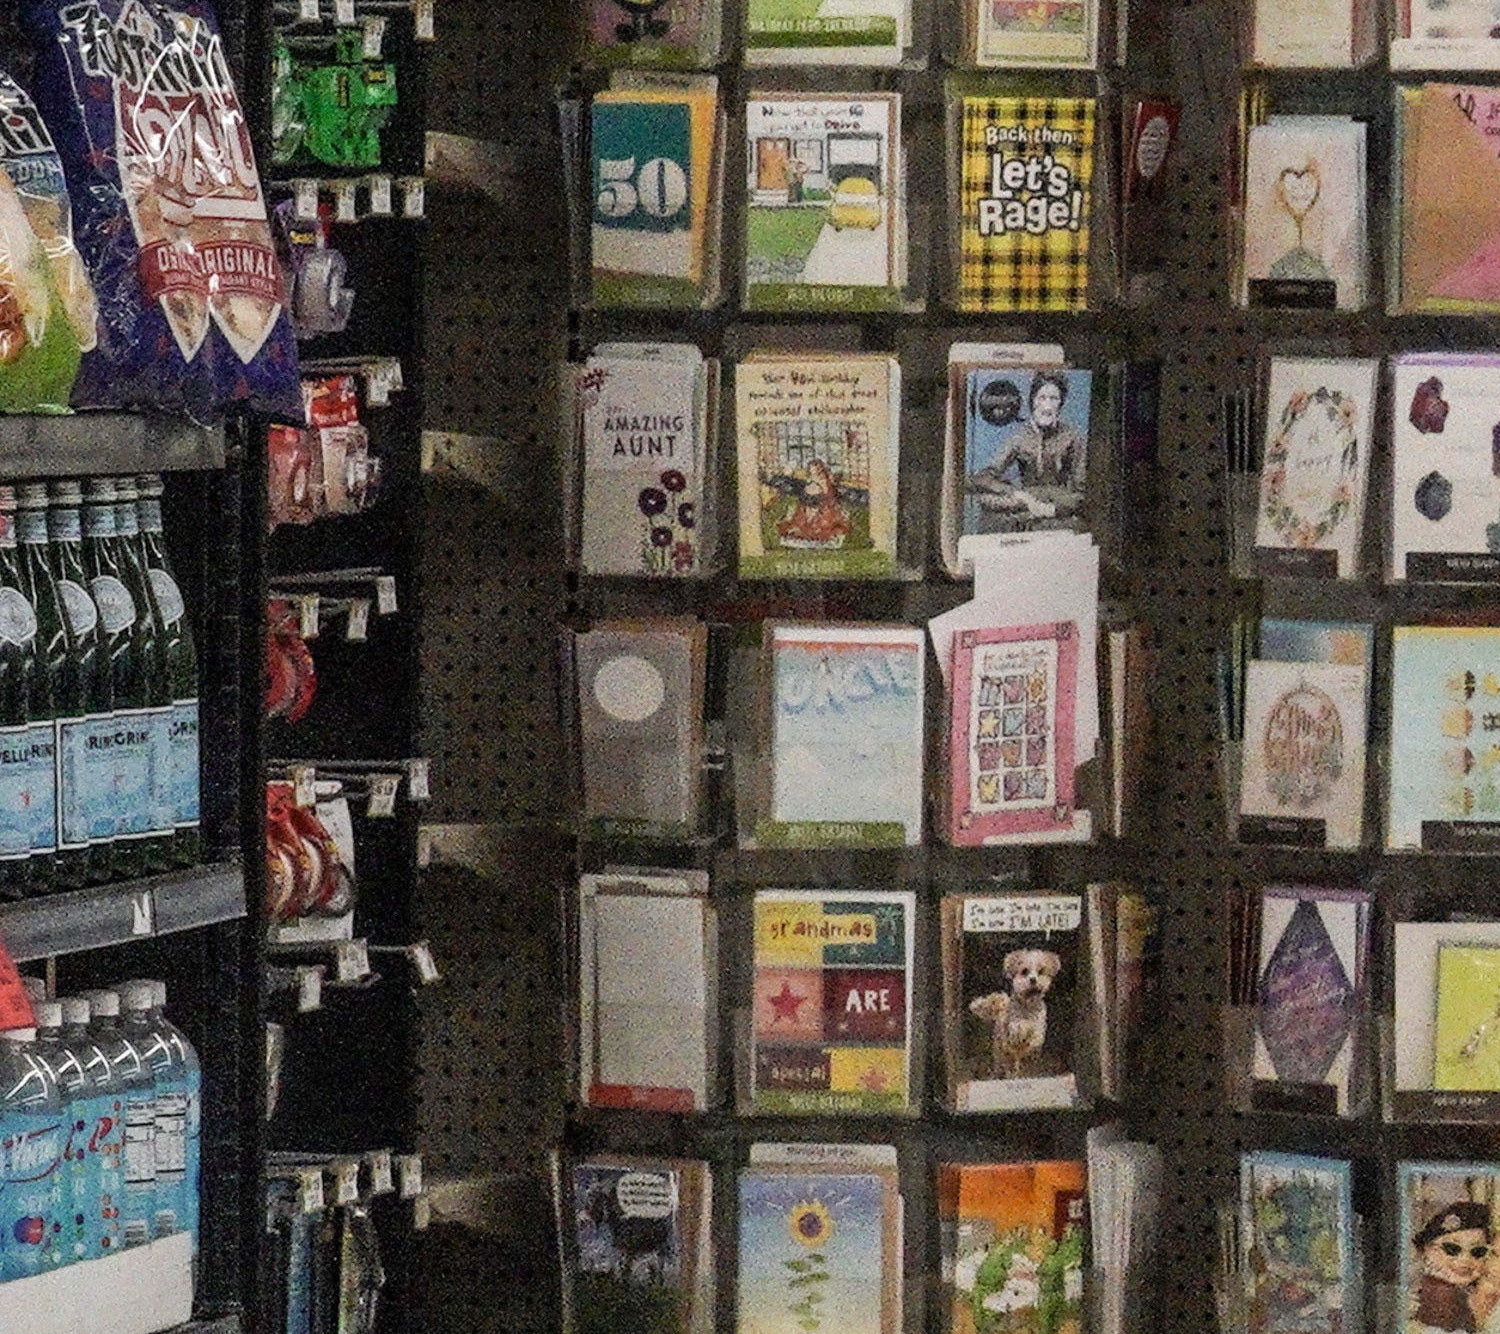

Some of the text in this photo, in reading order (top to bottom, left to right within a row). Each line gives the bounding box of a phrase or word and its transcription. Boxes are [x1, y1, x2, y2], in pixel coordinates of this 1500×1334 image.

[985, 125, 1029, 145] Back
[598, 155, 689, 219] 50
[992, 153, 1069, 198] Let's
[979, 192, 1082, 235] Rage!
[200, 247, 276, 279] RIGINAL
[603, 416, 685, 433] AMAZING
[612, 434, 677, 458] AUNT
[769, 917, 874, 941] grandmas
[845, 989, 891, 1014] ARE
